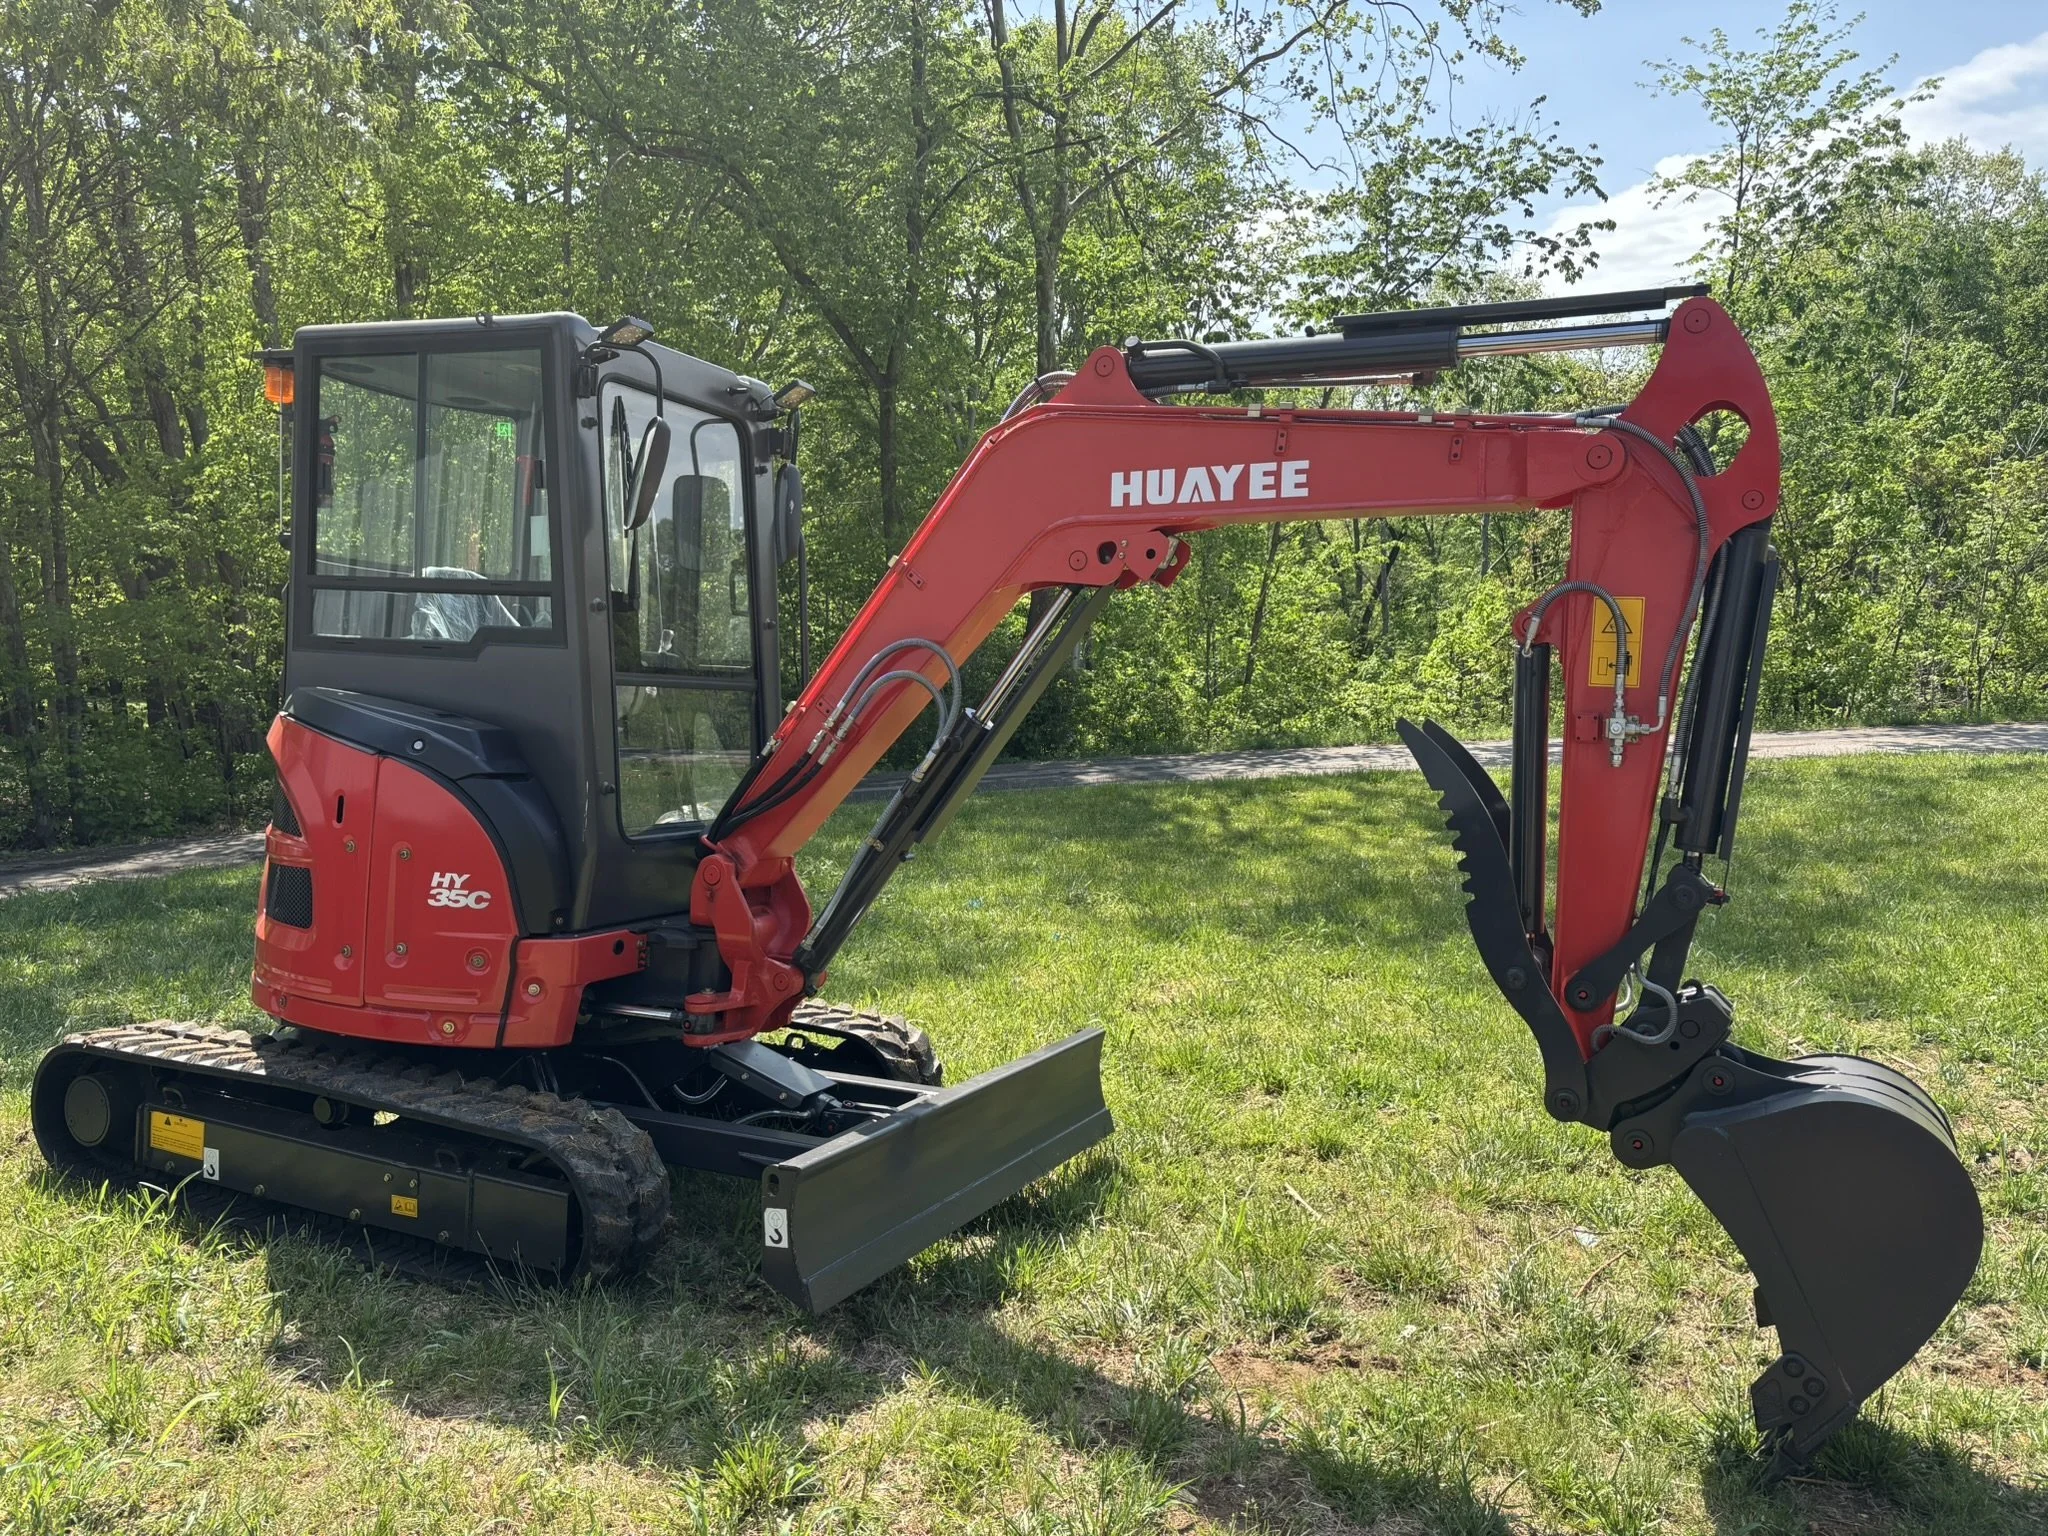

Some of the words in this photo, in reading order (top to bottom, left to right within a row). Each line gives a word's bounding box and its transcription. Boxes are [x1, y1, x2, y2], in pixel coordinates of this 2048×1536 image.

[1110, 460, 1310, 507] HUAYEE
[430, 871, 471, 889] HY
[427, 888, 491, 909] 35C
